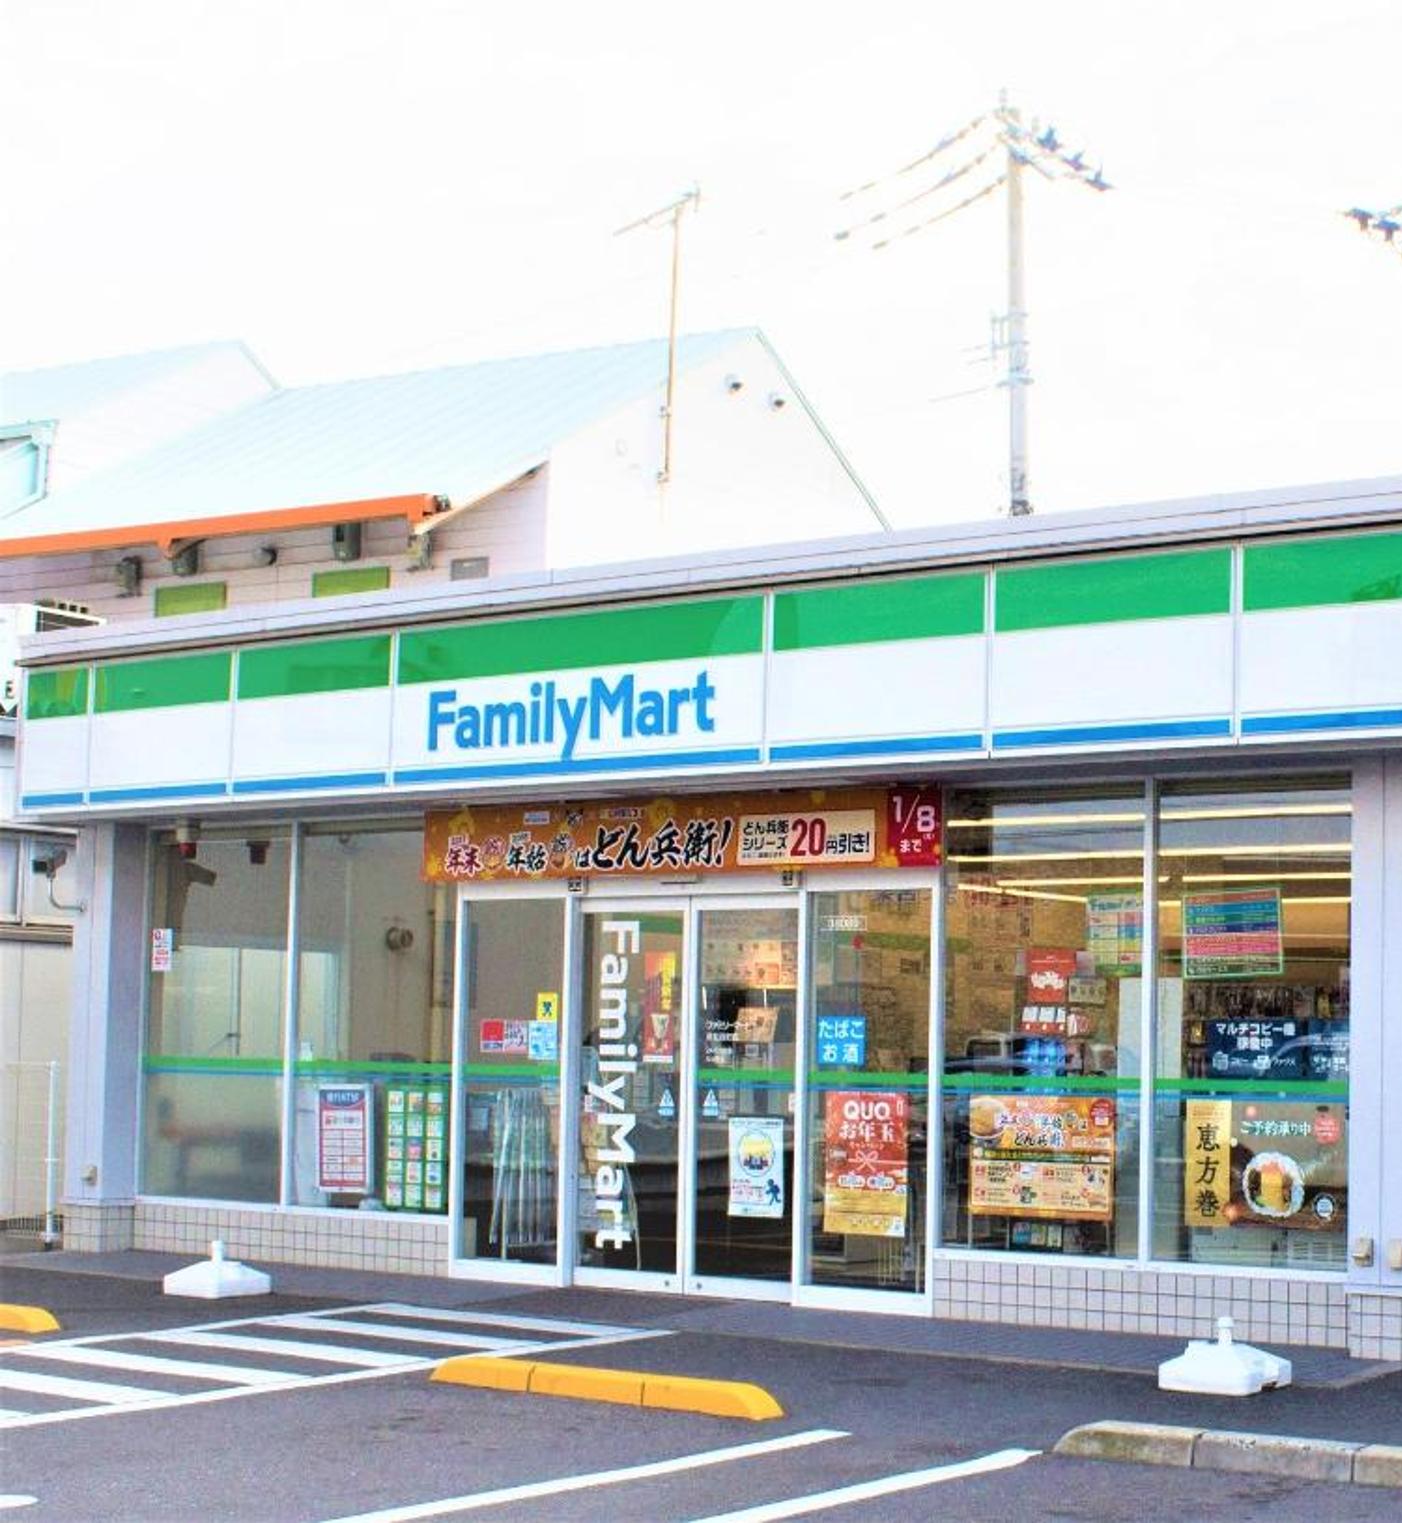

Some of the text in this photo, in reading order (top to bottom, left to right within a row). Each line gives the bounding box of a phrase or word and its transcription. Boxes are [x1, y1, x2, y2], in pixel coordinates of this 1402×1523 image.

[428, 670, 715, 761] FamilyMart
[892, 794, 936, 833] 1/8
[743, 835, 788, 851] シリーズ
[900, 838, 922, 853] まで
[818, 1021, 865, 1039] たばこ
[822, 1043, 860, 1063] お酒
[588, 920, 640, 1250] FamilyMart
[844, 1100, 890, 1120] QUO
[838, 1121, 895, 1143] お年玉
[1240, 1120, 1312, 1137] ご予約承り中
[1195, 1123, 1221, 1218] 恵方巻
